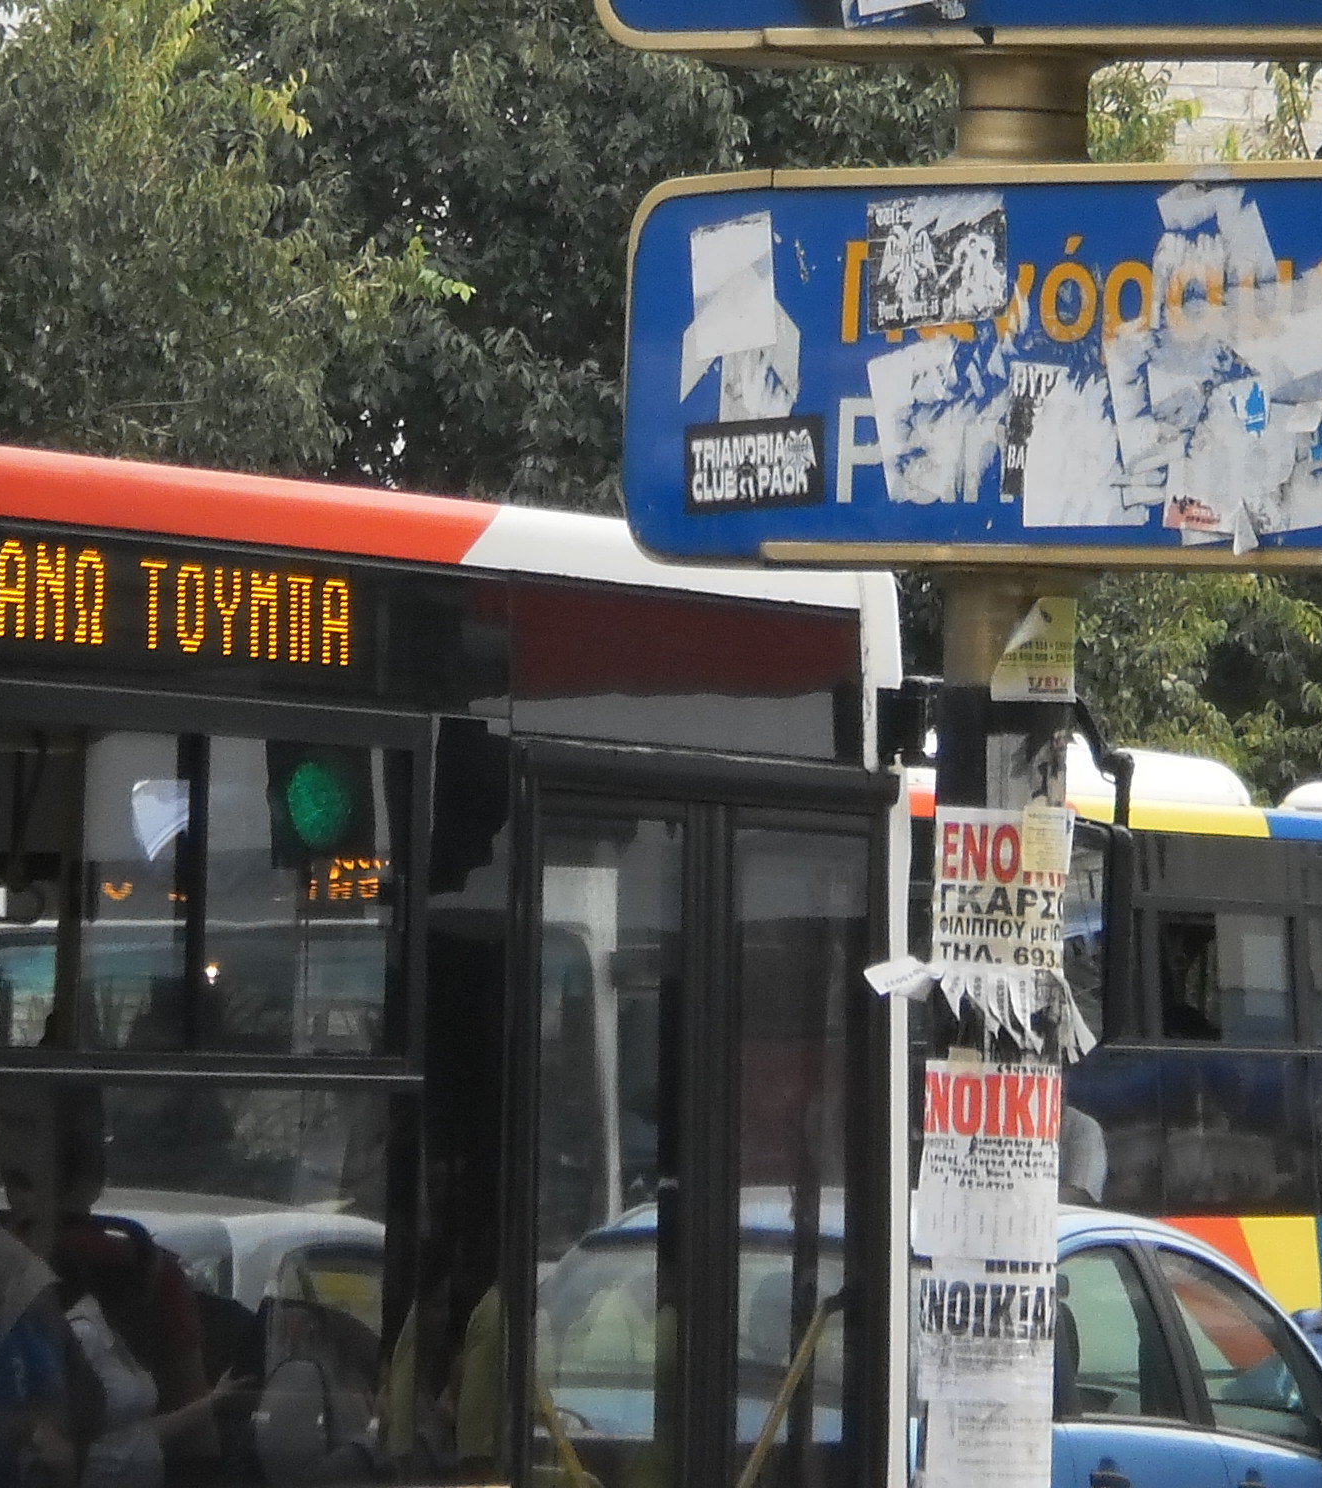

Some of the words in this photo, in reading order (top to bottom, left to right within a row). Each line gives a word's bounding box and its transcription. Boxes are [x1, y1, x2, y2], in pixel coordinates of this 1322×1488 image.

[690, 431, 787, 472] TRIANDRIA
[757, 466, 809, 498] PAOK
[139, 557, 350, 667] ΤΟΥΜΠΑ
[939, 916, 1026, 940] ΦΙΛΙΠΠΟΥ
[939, 941, 1003, 965] ΤΗΛ.
